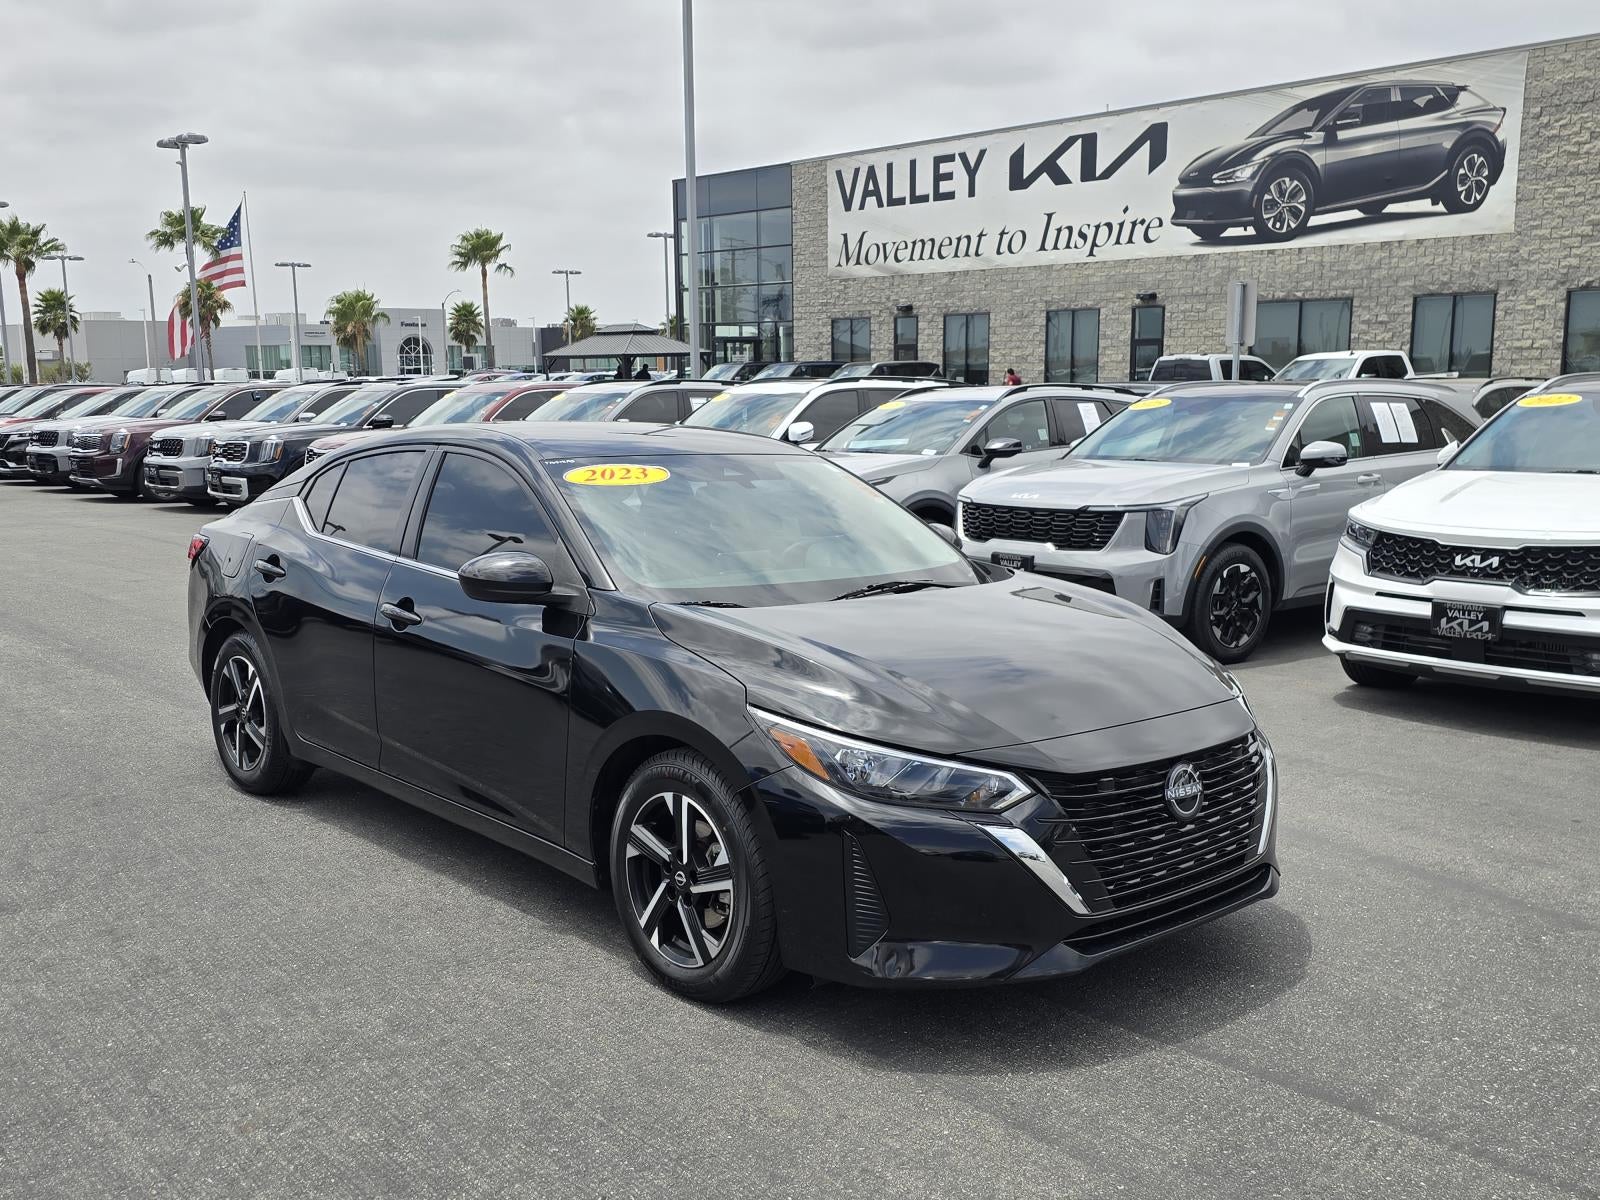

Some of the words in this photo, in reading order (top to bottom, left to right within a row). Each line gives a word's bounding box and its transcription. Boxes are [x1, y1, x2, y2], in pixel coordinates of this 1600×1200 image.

[835, 147, 988, 213] VALLEY
[1008, 121, 1169, 192] KIA
[835, 227, 988, 268] Movement
[995, 225, 1027, 256] to
[1035, 205, 1164, 258] Inspire
[583, 467, 649, 482] 2023
[1455, 554, 1499, 568] KIA
[1447, 609, 1484, 620] VALLEY
[1440, 617, 1489, 632] KIA
[1167, 784, 1202, 798] NISSAN
